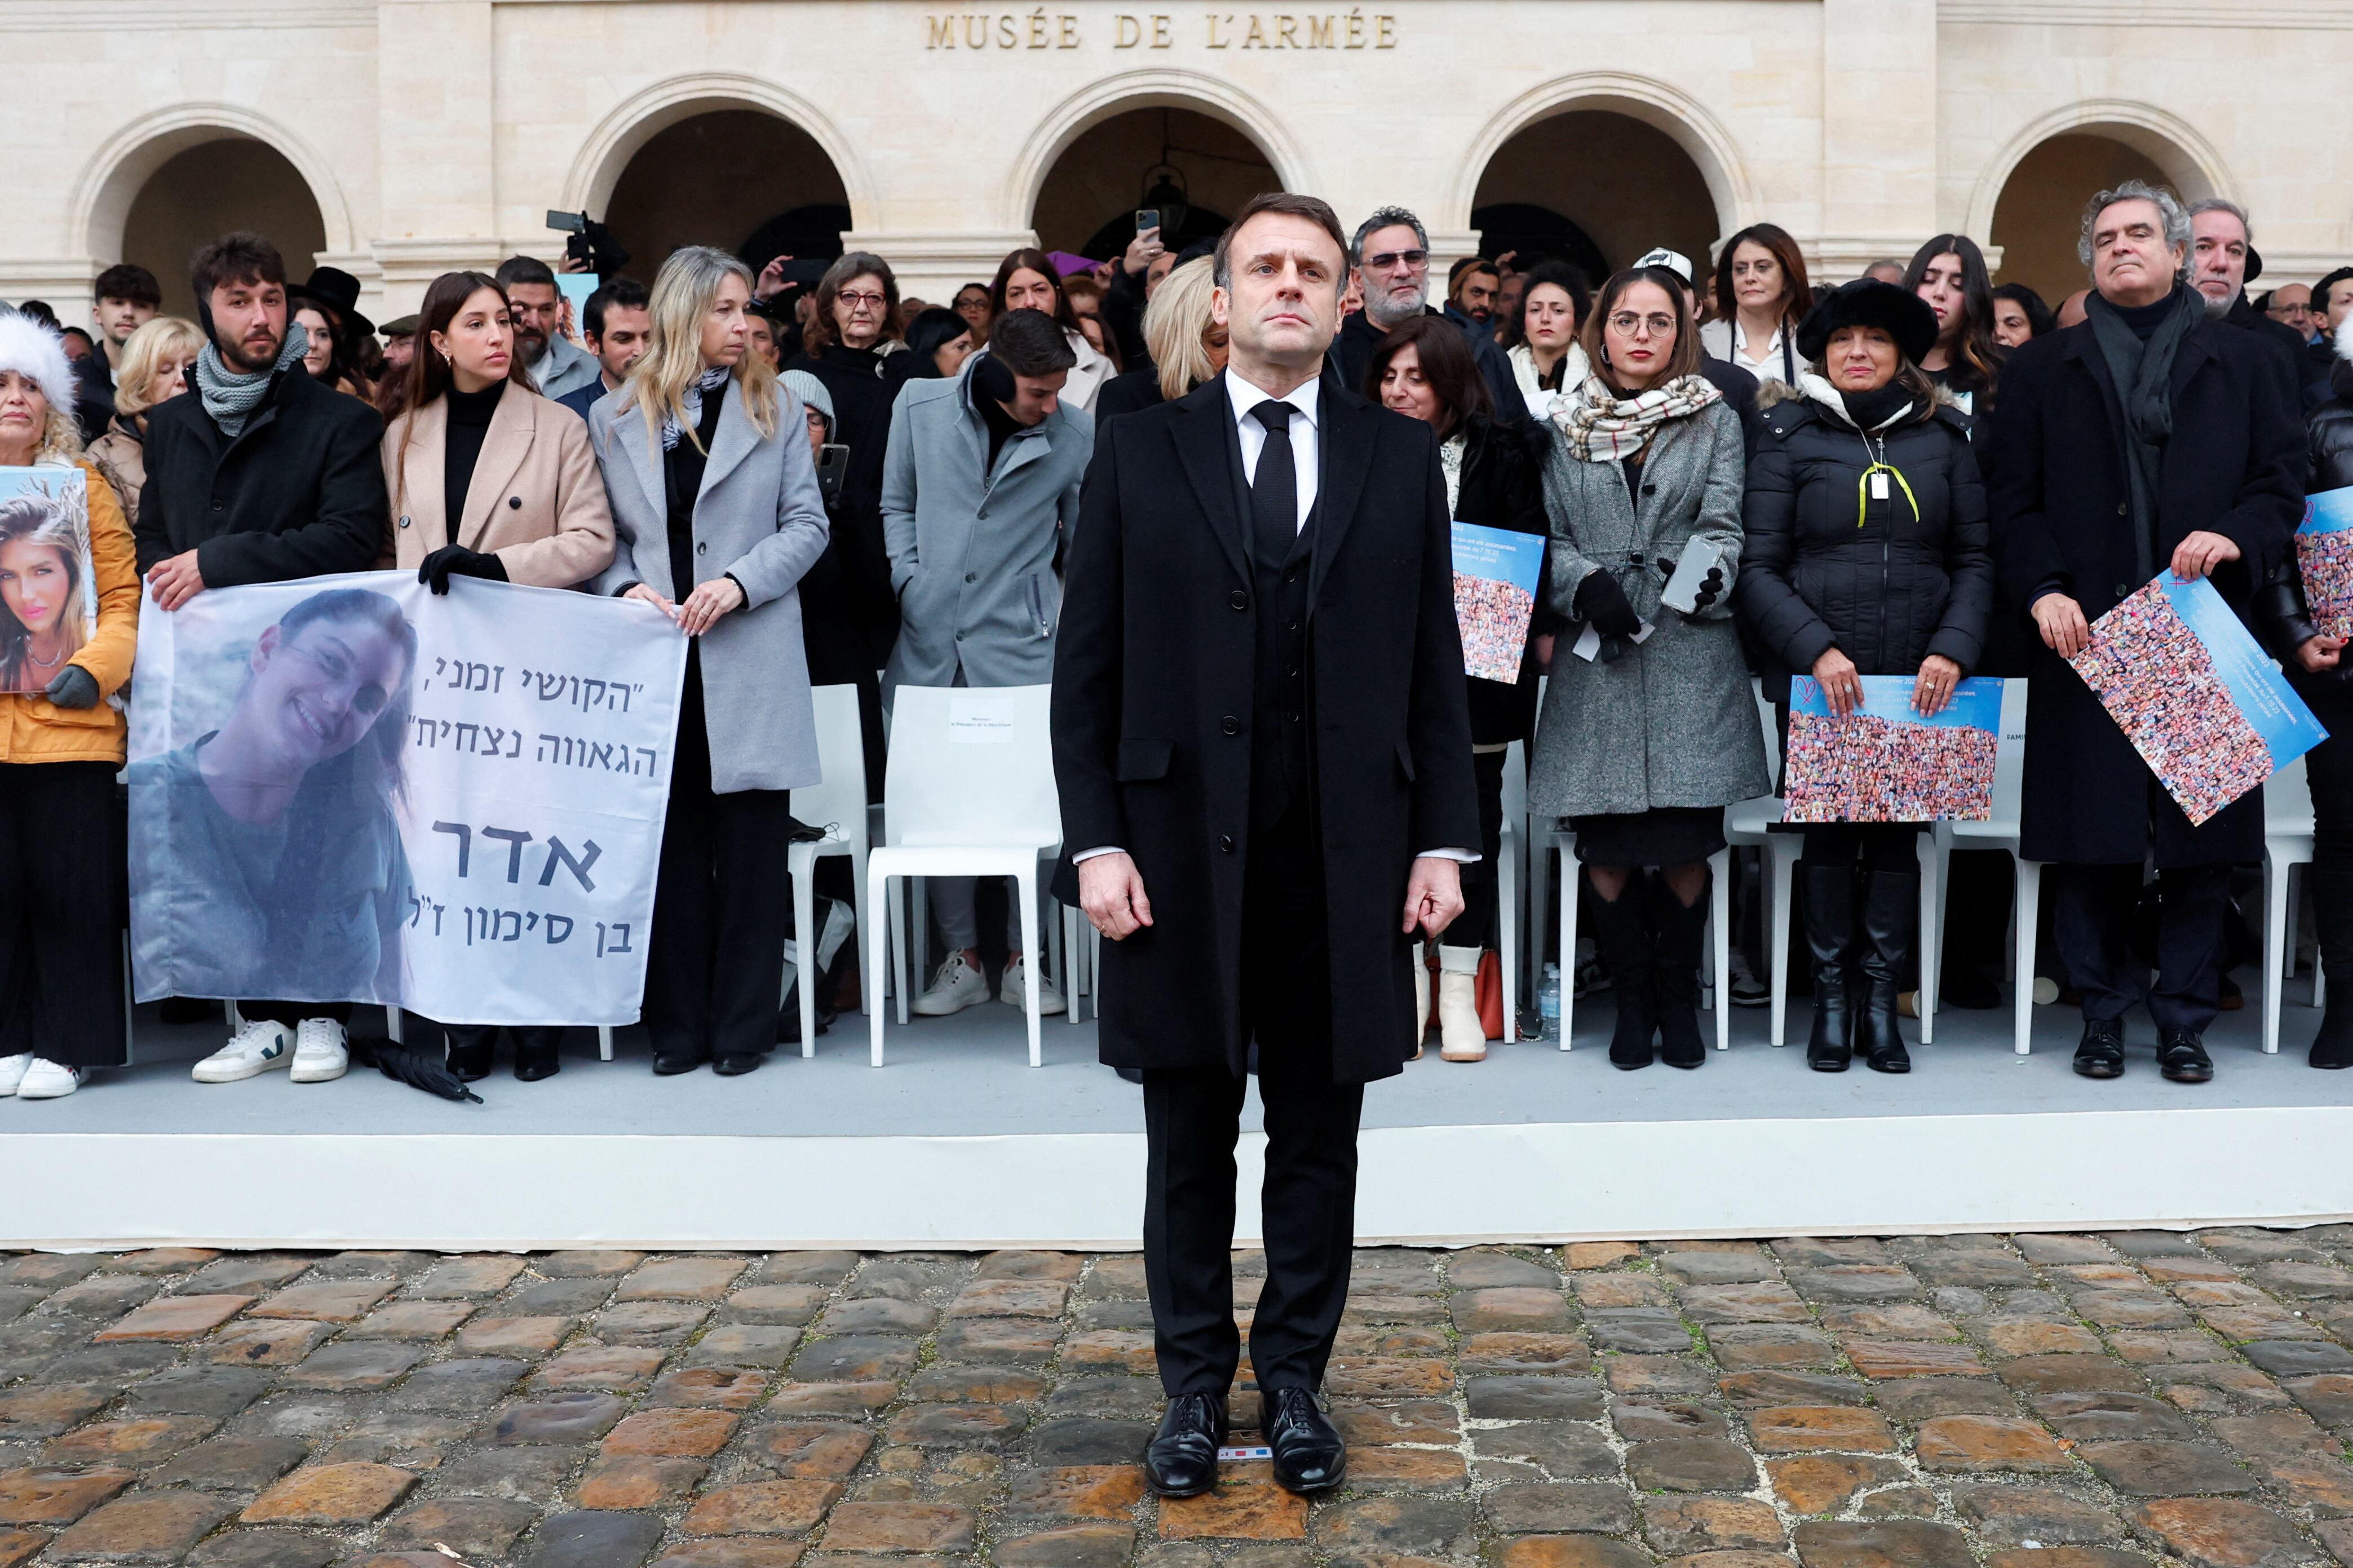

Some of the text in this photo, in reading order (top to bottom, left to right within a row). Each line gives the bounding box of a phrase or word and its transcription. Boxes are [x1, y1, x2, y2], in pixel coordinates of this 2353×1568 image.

[926, 7, 1398, 50] MUSÉE DE L'ARMÉE
[424, 656, 505, 693] זמני,
[2255, 651, 2271, 668] 2023
[537, 732, 657, 778] הגאווה
[432, 820, 603, 893] אדר
[464, 905, 574, 946] סימון
[595, 920, 633, 958] בן
